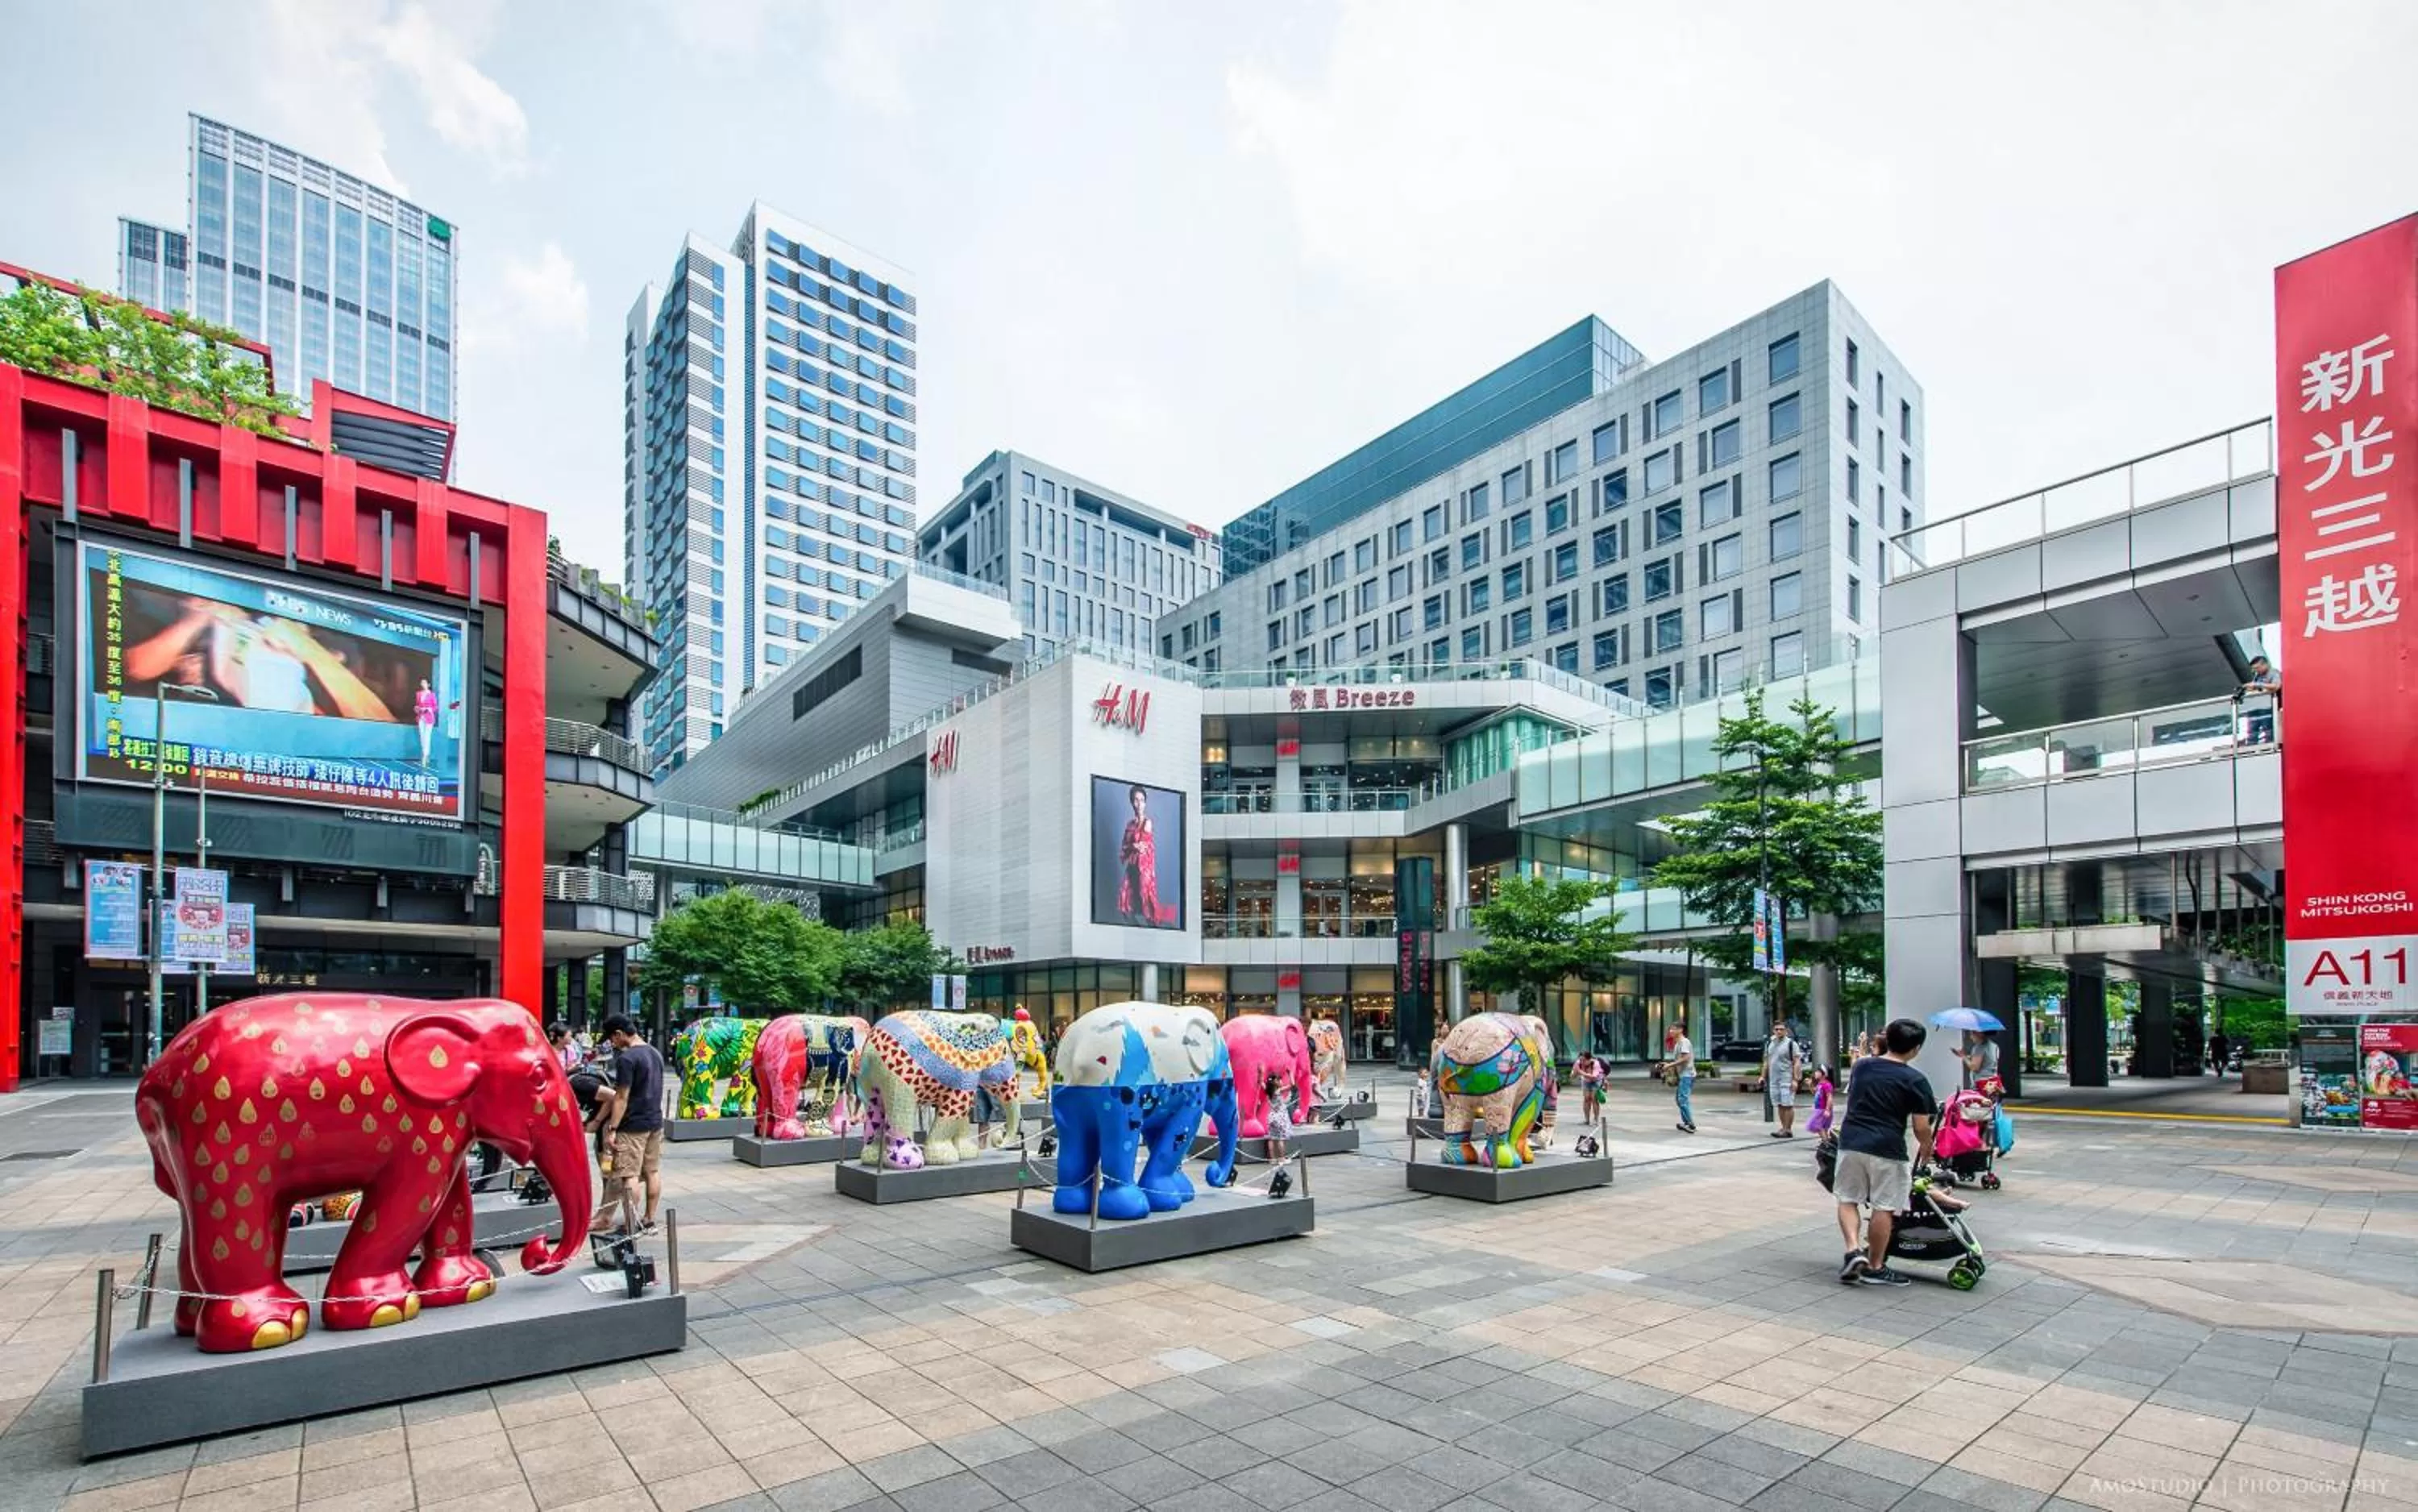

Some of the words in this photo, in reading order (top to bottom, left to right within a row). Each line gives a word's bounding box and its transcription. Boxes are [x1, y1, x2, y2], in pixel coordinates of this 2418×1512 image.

[2300, 333, 2399, 638] 新光三越
[315, 605, 352, 625] NEWS
[1093, 681, 1150, 735] H&M
[1335, 687, 1415, 708] Breeze
[2300, 902, 2413, 918] MITSUKOSHI
[2308, 895, 2349, 908] SHIN
[2354, 891, 2406, 903] KONG
[2304, 947, 2406, 987] A11
